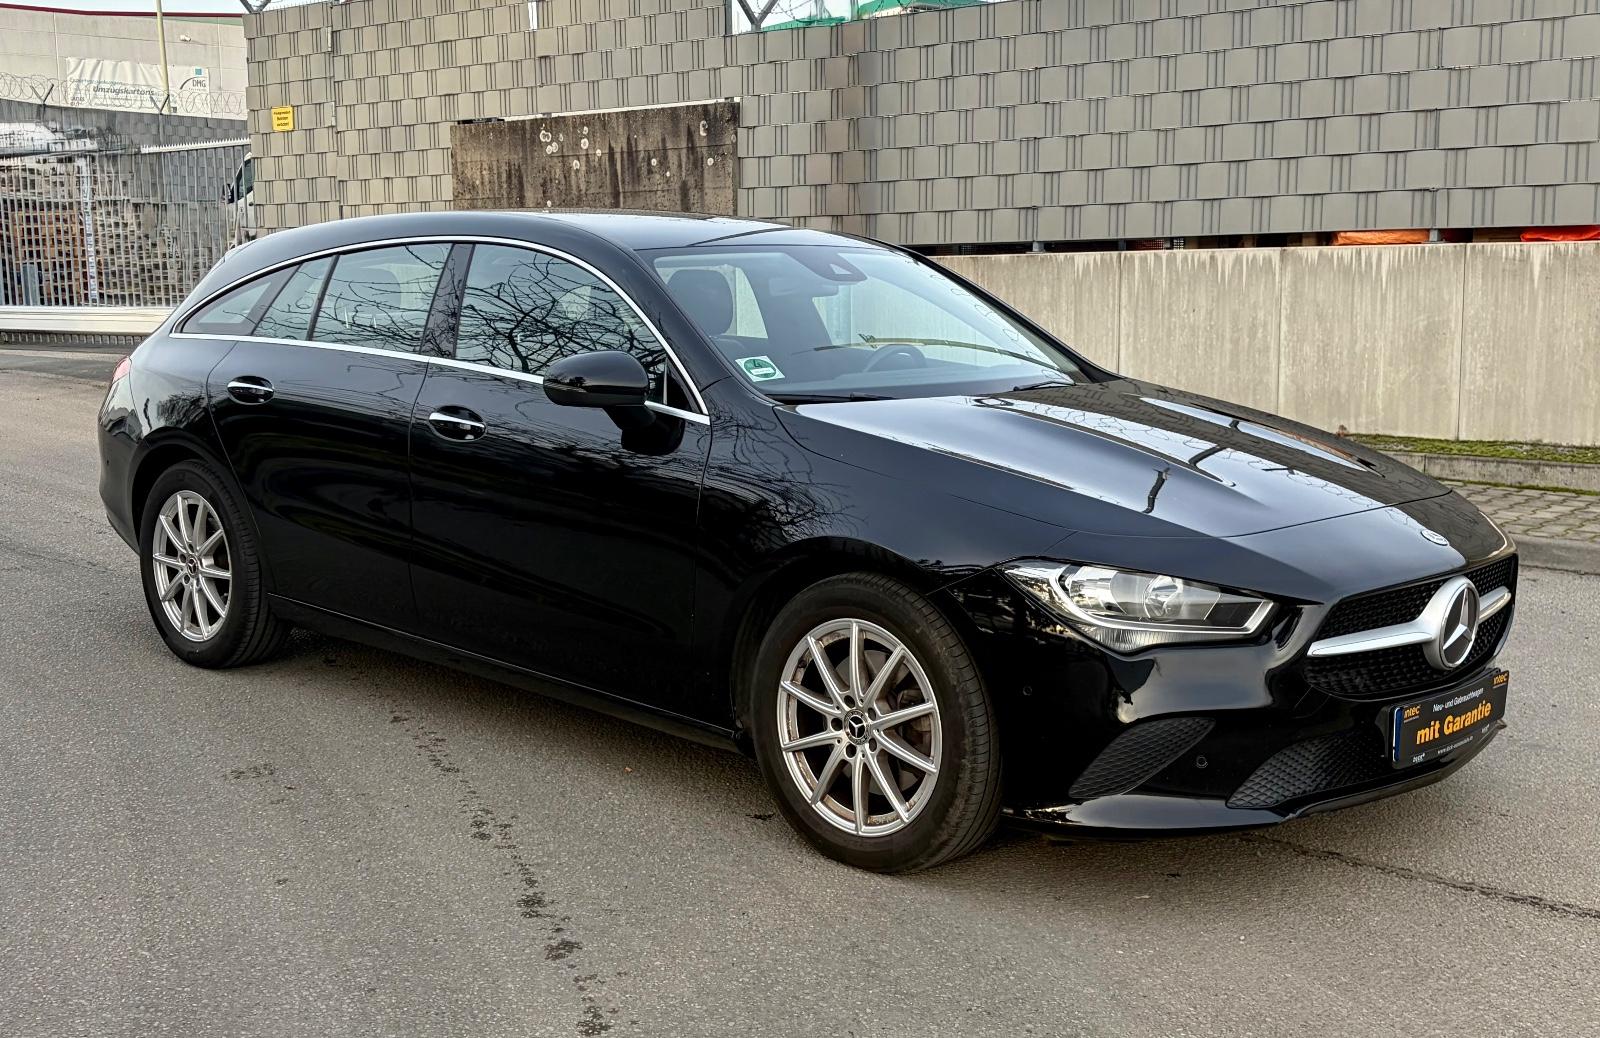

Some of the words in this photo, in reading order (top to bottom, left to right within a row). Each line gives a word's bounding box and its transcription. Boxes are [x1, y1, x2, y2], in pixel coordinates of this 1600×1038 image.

[92, 85, 154, 96] Umzugskartons
[1404, 705, 1421, 719] intec
[1433, 703, 1444, 712] Neu-
[1445, 698, 1454, 709] und
[1416, 720, 1440, 745] mit
[1443, 700, 1492, 735] Garantie
